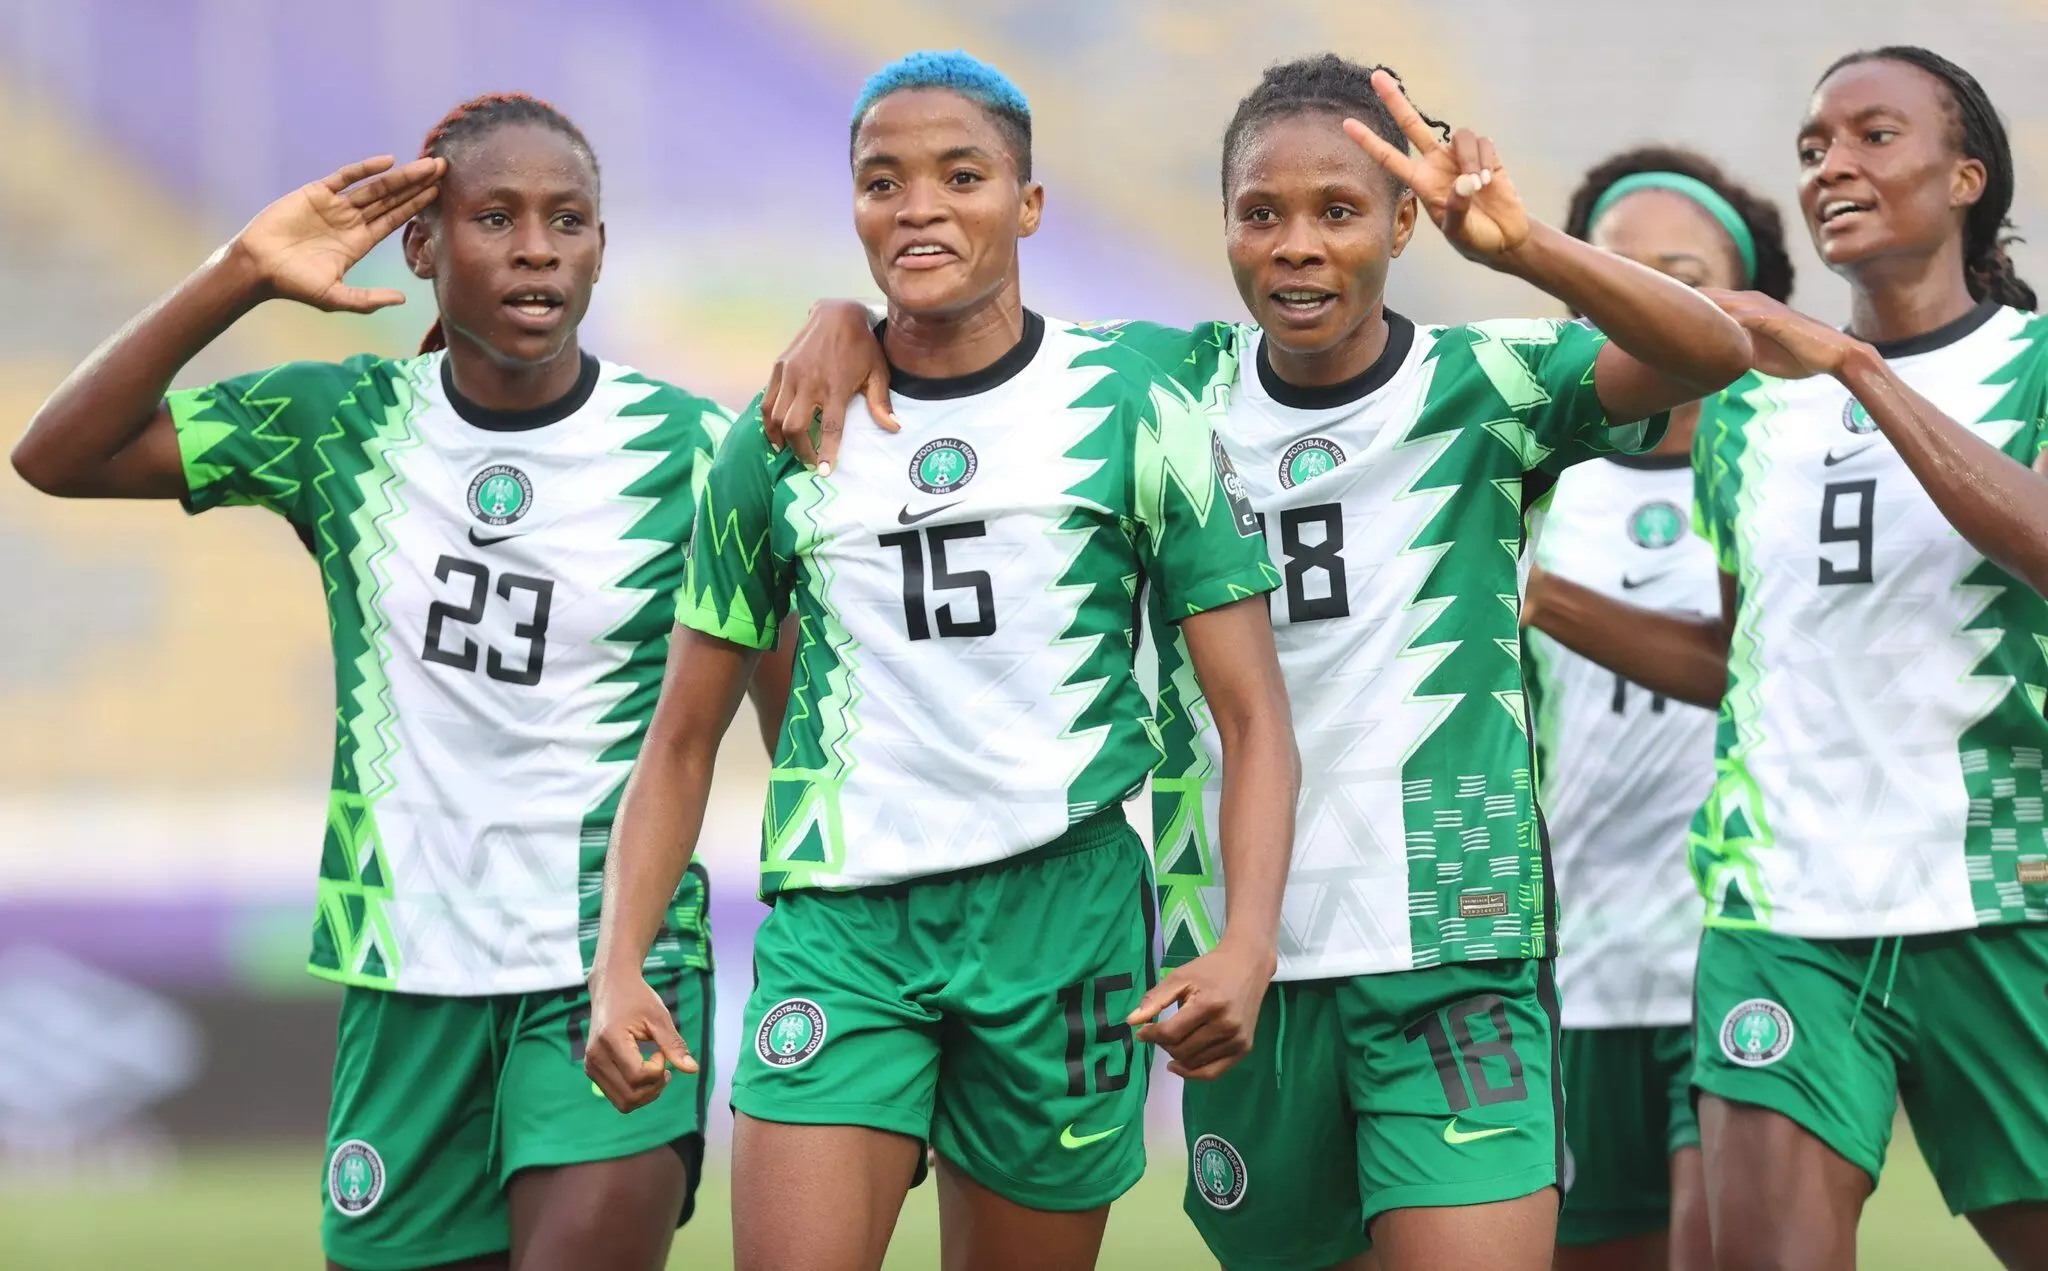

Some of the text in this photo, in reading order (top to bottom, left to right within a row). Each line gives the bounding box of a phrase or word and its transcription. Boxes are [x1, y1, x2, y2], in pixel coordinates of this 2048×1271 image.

[916, 440, 958, 460] FOOTBALL
[958, 443, 976, 485] FEDERATION
[1281, 458, 1293, 488] NIGERIA
[1287, 440, 1328, 459] FOOTBALL
[1818, 478, 1877, 586] 9
[421, 554, 555, 686] 23
[877, 520, 997, 641] 15
[760, 1003, 822, 1057] NIGERIA FOOTBALL FEDERATION
[778, 1056, 797, 1064] 1945
[1056, 972, 1135, 1096] 15
[1404, 993, 1529, 1113] 18
[1197, 1140, 1223, 1157] FOOTBALL
[1223, 1147, 1243, 1198] FEDERATION
